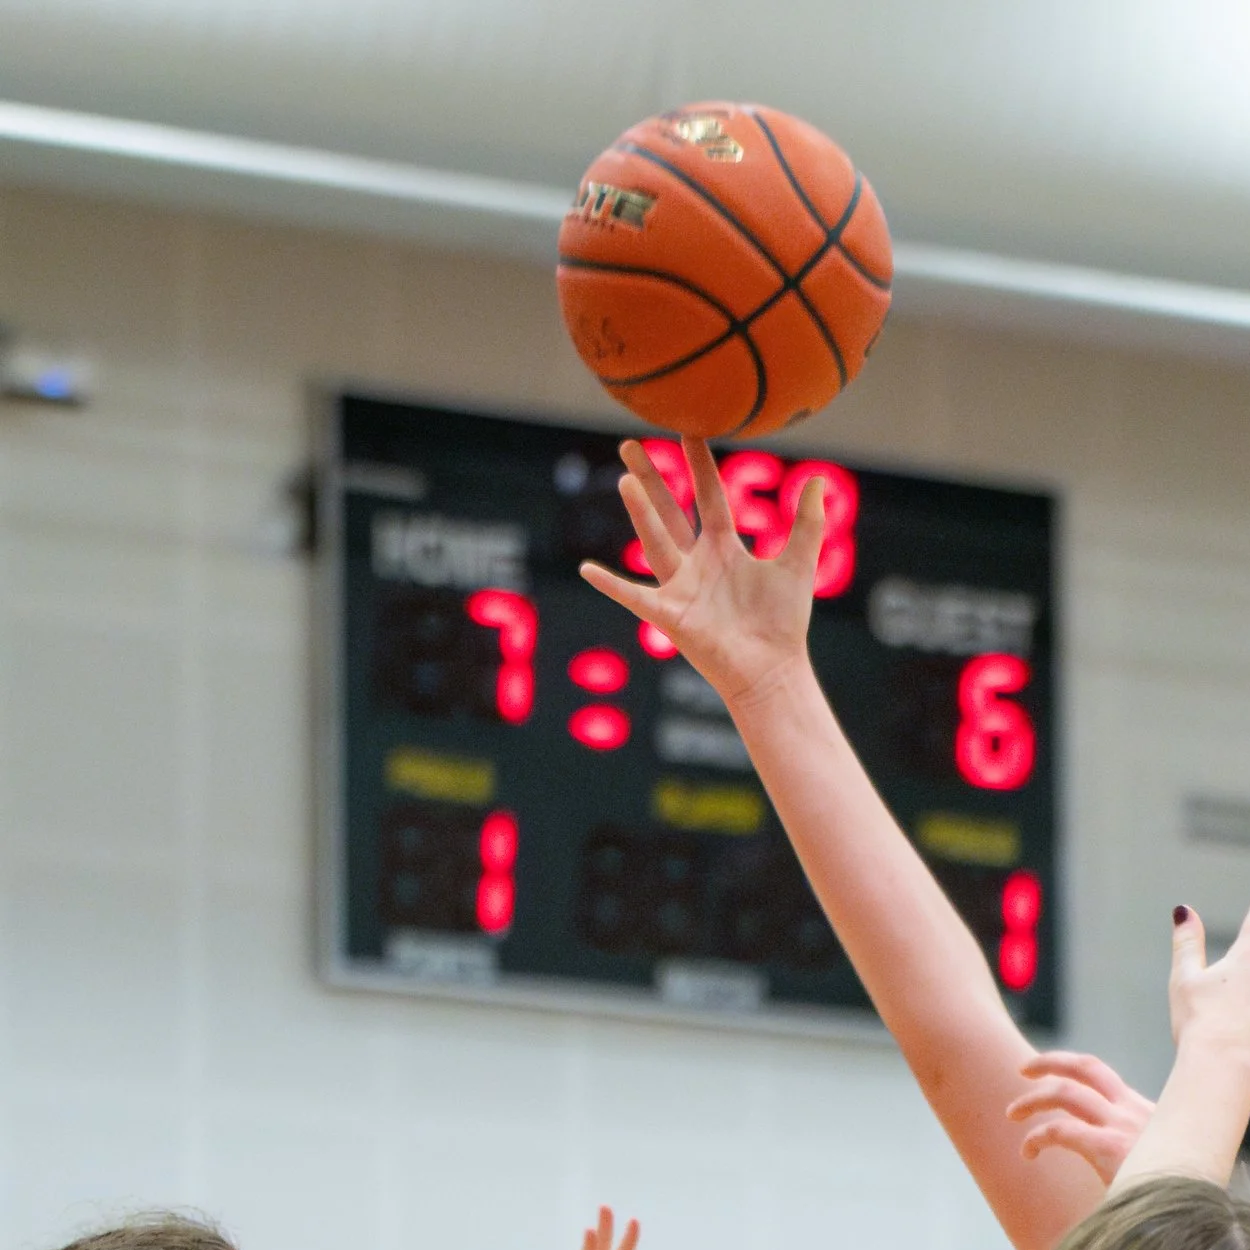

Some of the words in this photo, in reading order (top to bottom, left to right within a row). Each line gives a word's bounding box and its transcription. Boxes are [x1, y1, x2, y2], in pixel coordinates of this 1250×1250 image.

[466, 588, 538, 725] 7
[955, 653, 1035, 791] 6
[476, 811, 518, 934] 1
[999, 872, 1042, 992] 1
